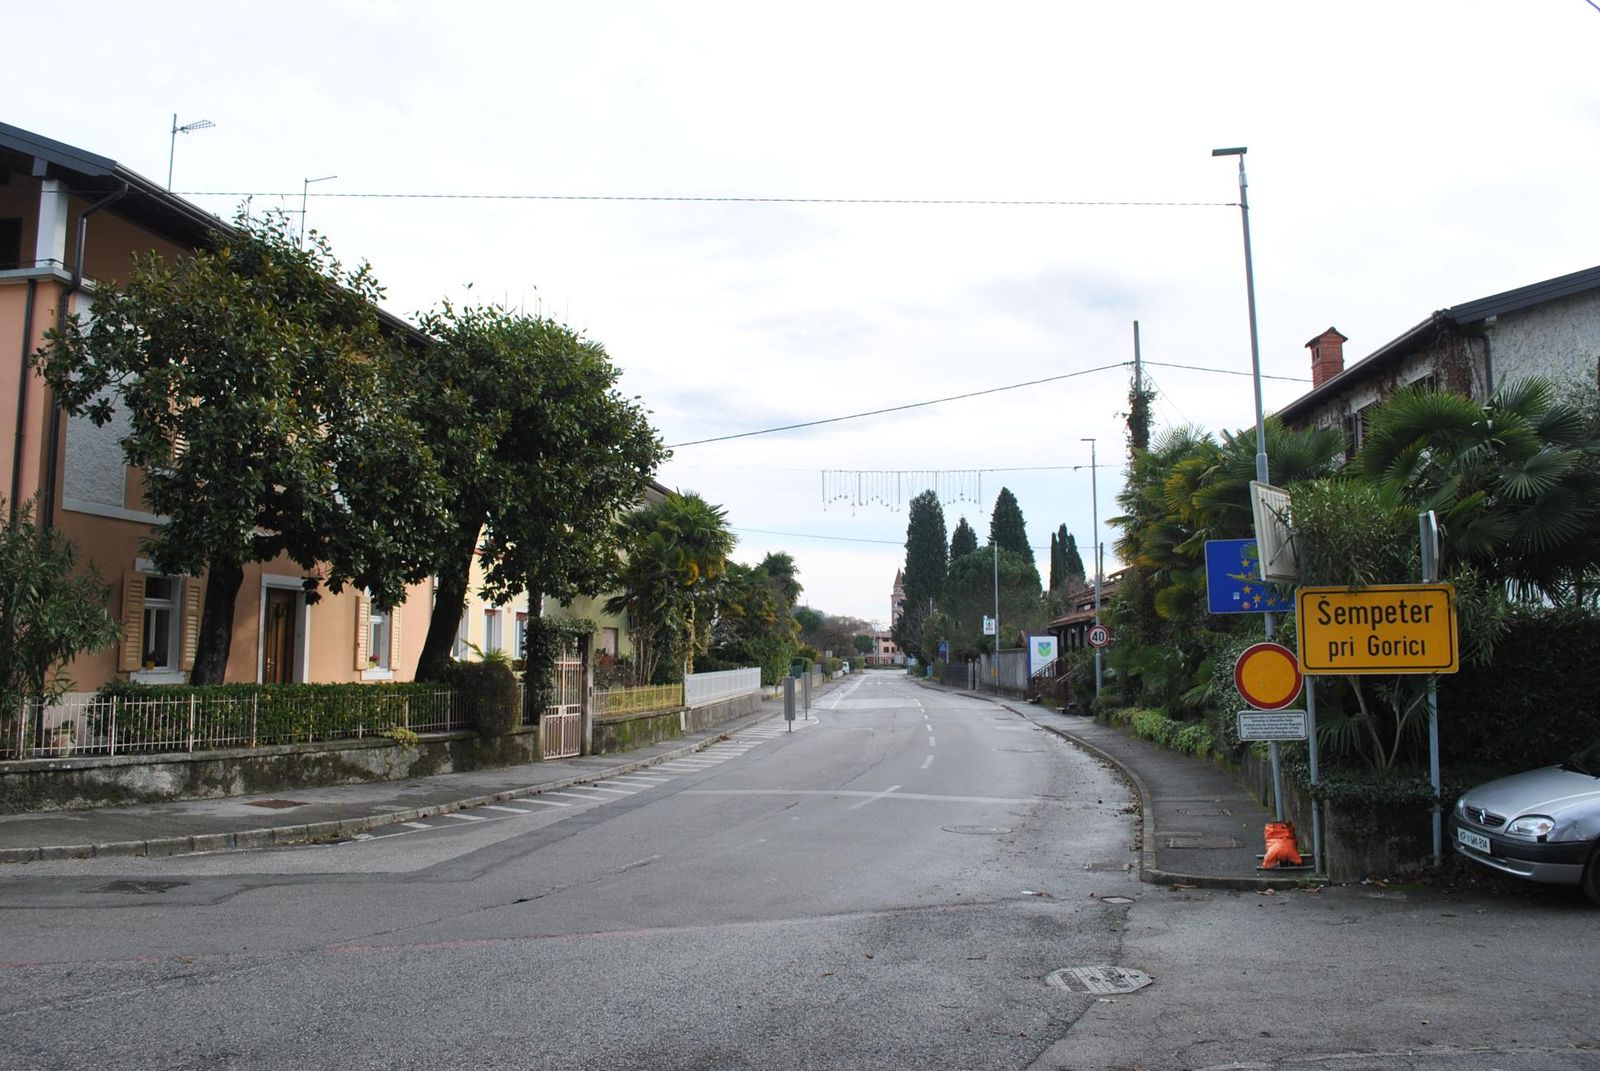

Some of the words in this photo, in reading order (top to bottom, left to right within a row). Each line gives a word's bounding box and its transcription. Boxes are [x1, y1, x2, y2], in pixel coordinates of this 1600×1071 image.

[1317, 595, 1434, 631] Šempeter
[1092, 631, 1104, 641] 40
[1329, 636, 1354, 662] pri
